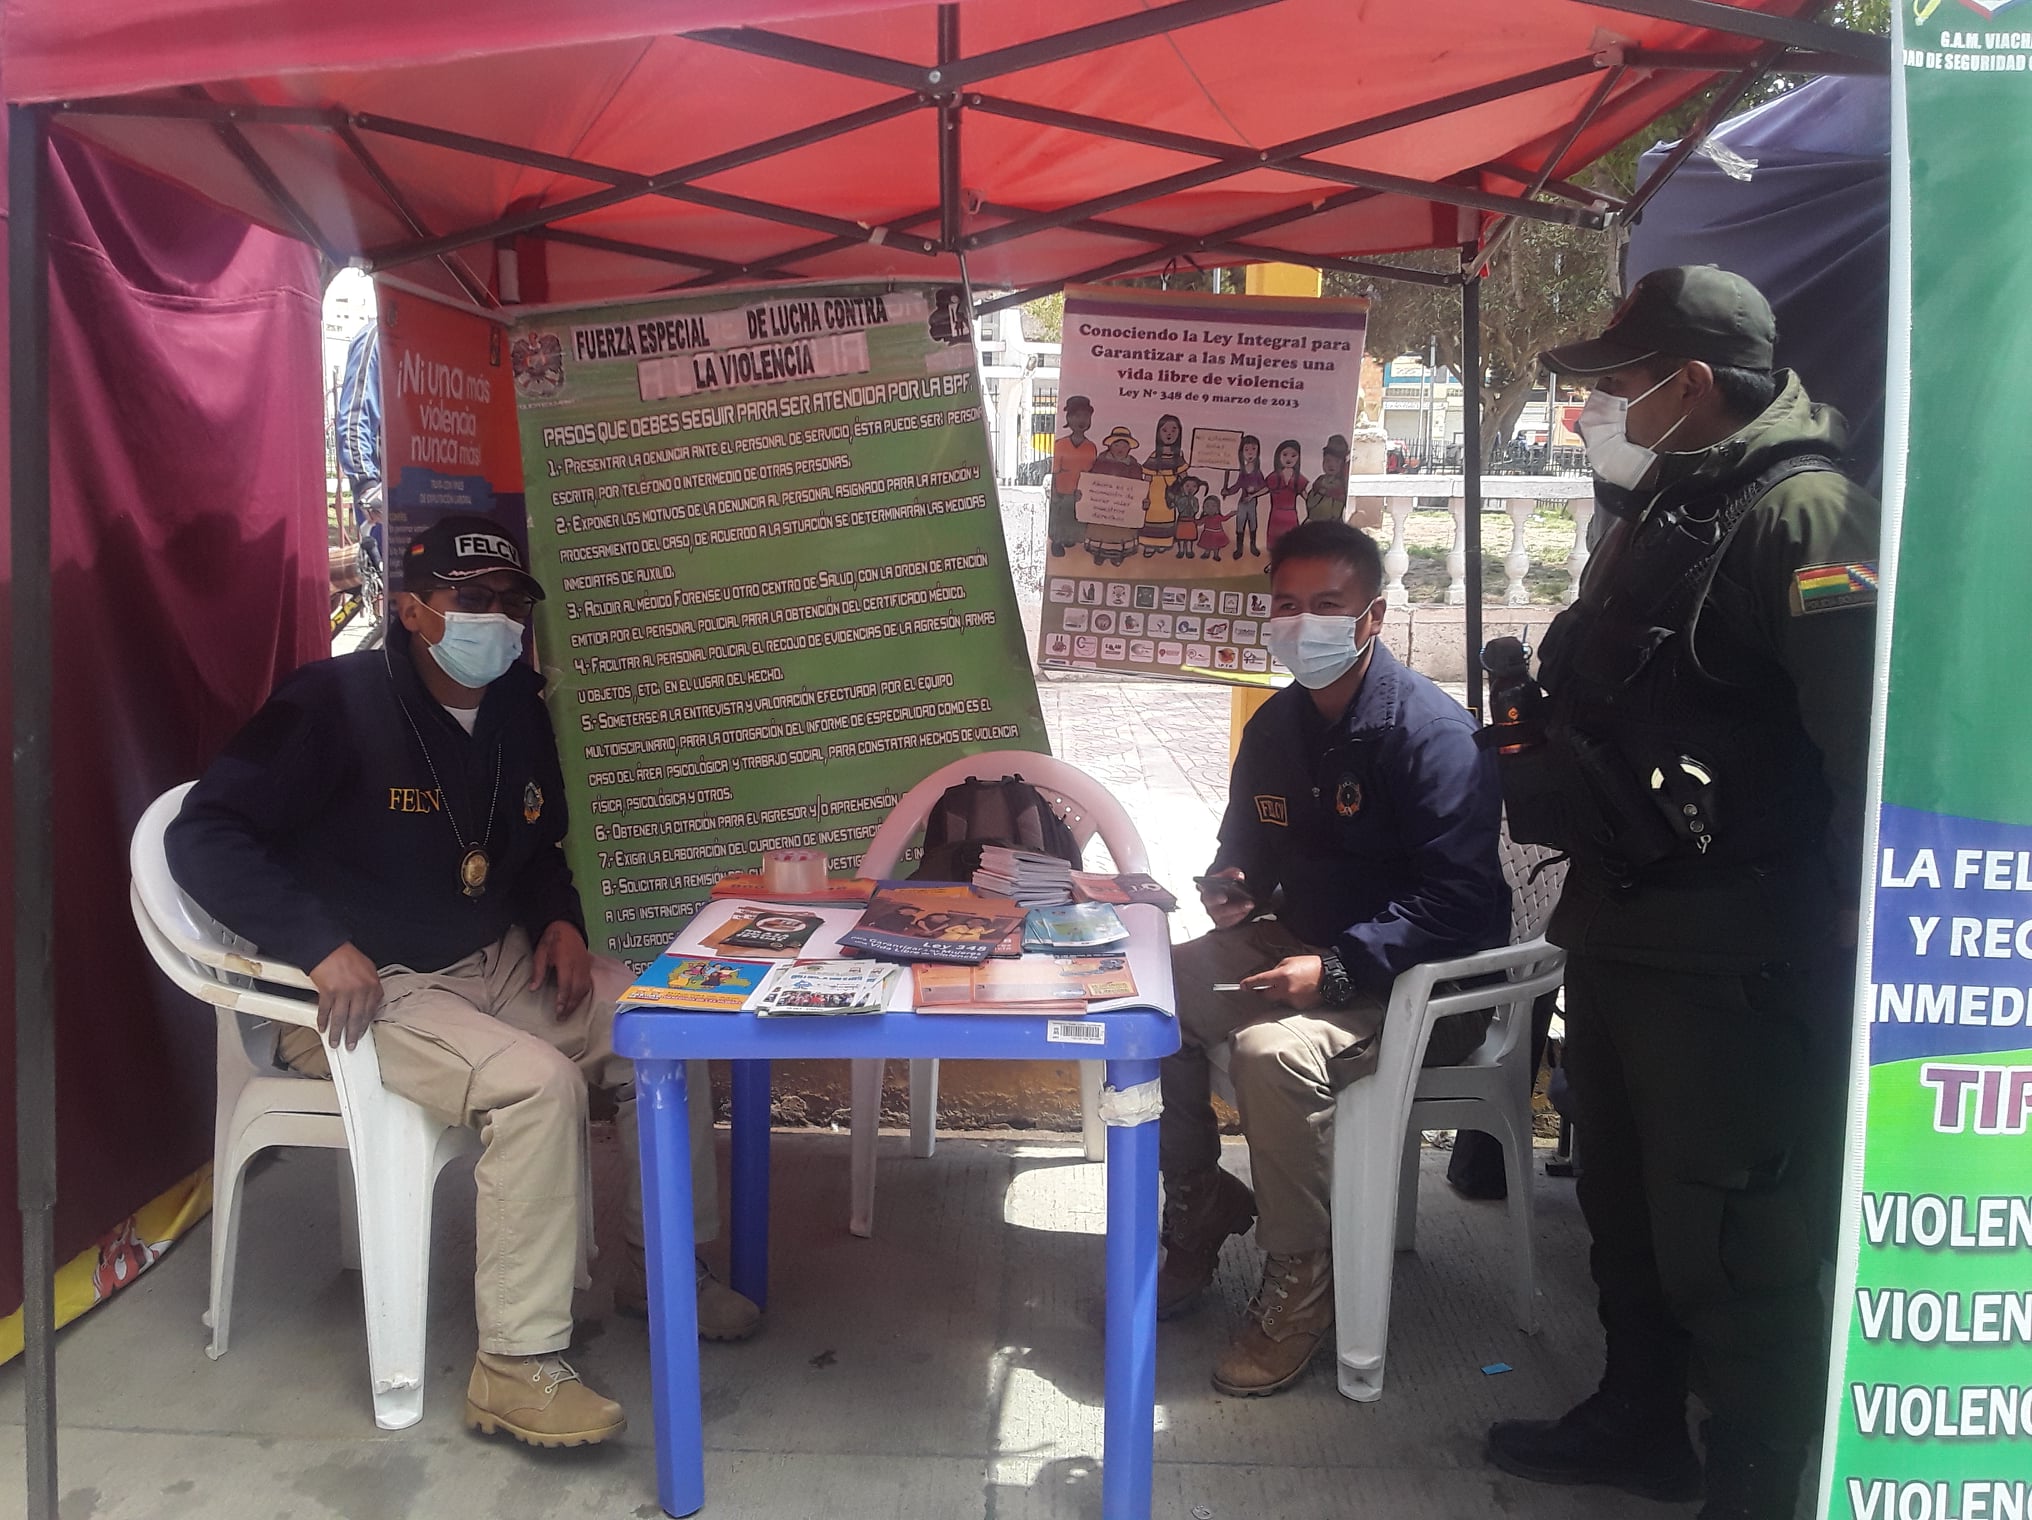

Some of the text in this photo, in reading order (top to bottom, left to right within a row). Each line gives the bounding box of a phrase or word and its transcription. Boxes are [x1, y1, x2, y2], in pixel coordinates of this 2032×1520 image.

[1940, 31, 2032, 50] G.A.M. VIACH
[1926, 52, 1942, 69] DE
[1944, 53, 2026, 71] SEGURIDAD
[575, 295, 888, 360] FUERZA ESPECIAL DE LUCHA CONTRA
[1079, 324, 1351, 352] Conociendo la Ley Integral para
[693, 344, 814, 389] LA VIOLENCIA
[1091, 346, 1335, 372] Garantizar a las Mujeres una
[1117, 368, 1304, 390] vida libre de violencia
[428, 361, 464, 400] una
[466, 374, 490, 404] más
[1119, 387, 1140, 399] Ley
[1160, 391, 1182, 401] 348
[1185, 392, 1199, 402] de
[1212, 394, 1250, 404] marzo
[1254, 395, 1268, 406] de
[1271, 397, 1300, 409] 2013
[420, 399, 476, 436] violencia
[543, 422, 595, 448] PASOS
[596, 418, 628, 442] QUE
[629, 411, 680, 437] DEBES
[680, 403, 735, 430] SEGUIR
[736, 398, 778, 422] PARA
[778, 393, 811, 417] SER
[812, 383, 886, 412] ATENDIDA
[887, 379, 920, 402] POR
[920, 376, 941, 398] LA
[411, 435, 458, 464] nunca
[564, 453, 626, 475] PRESENTAR
[627, 452, 641, 466] LA
[642, 445, 690, 464] DENUNCIA
[690, 442, 717, 458] ANTE
[719, 440, 733, 454] EL
[733, 433, 786, 453] PERSONAL
[787, 431, 802, 446] DE
[804, 424, 852, 443] SERVICIO,
[882, 415, 918, 433] PUEDE
[551, 487, 597, 506] ESCRITA,
[598, 484, 620, 500] POR
[673, 476, 682, 490] O
[682, 468, 742, 489] INTERMEDIO
[742, 466, 758, 481] DE
[758, 461, 794, 479] OTRAS
[794, 453, 851, 474] PERSONAS.
[572, 513, 619, 532] EXPONER
[620, 511, 640, 526] LOS
[641, 505, 685, 523] MOTIVOS
[686, 502, 702, 517] DE
[702, 500, 716, 515] LA
[717, 494, 765, 513] DENUNCIA
[766, 492, 779, 506] AL
[781, 485, 833, 504] PERSONAL
[834, 478, 885, 497] ASIGNADO
[886, 474, 914, 491] PARA
[915, 472, 929, 487] LA
[559, 540, 640, 563] PROCESAMIENTO
[640, 537, 660, 553] DEL
[661, 532, 693, 552] CASO,
[693, 530, 709, 546] DE
[709, 524, 757, 544] ACUERDO
[757, 523, 767, 537] A
[767, 521, 781, 536] LA
[782, 510, 833, 534] SITUACIÓN
[834, 512, 849, 527] SE
[926, 499, 944, 515] LAS
[944, 494, 986, 513] MEDIDAS
[562, 571, 620, 591] INMEDIATAS
[620, 569, 635, 584] DE
[584, 599, 621, 618] ACUDIR
[622, 598, 635, 613] AL
[673, 587, 721, 606] FORENSE
[722, 585, 731, 600] U
[731, 582, 760, 599] OTRO
[761, 576, 801, 595] CENTRO
[802, 574, 817, 590] DE
[817, 569, 856, 588] SALUD,
[857, 566, 879, 583] CON
[879, 564, 893, 580] LA
[893, 560, 928, 578] ORDEN
[928, 558, 943, 574] DE
[943, 548, 988, 572] ATENCIÓN
[1880, 848, 1941, 888] LA
[604, 901, 693, 923] A LAS INSTANCIAS
[1908, 916, 1940, 956] Y
[1863, 1194, 2032, 1248] VIOLEN
[1856, 1289, 2032, 1342] VIOLEN
[1848, 1478, 2032, 1520] VIOLEN
